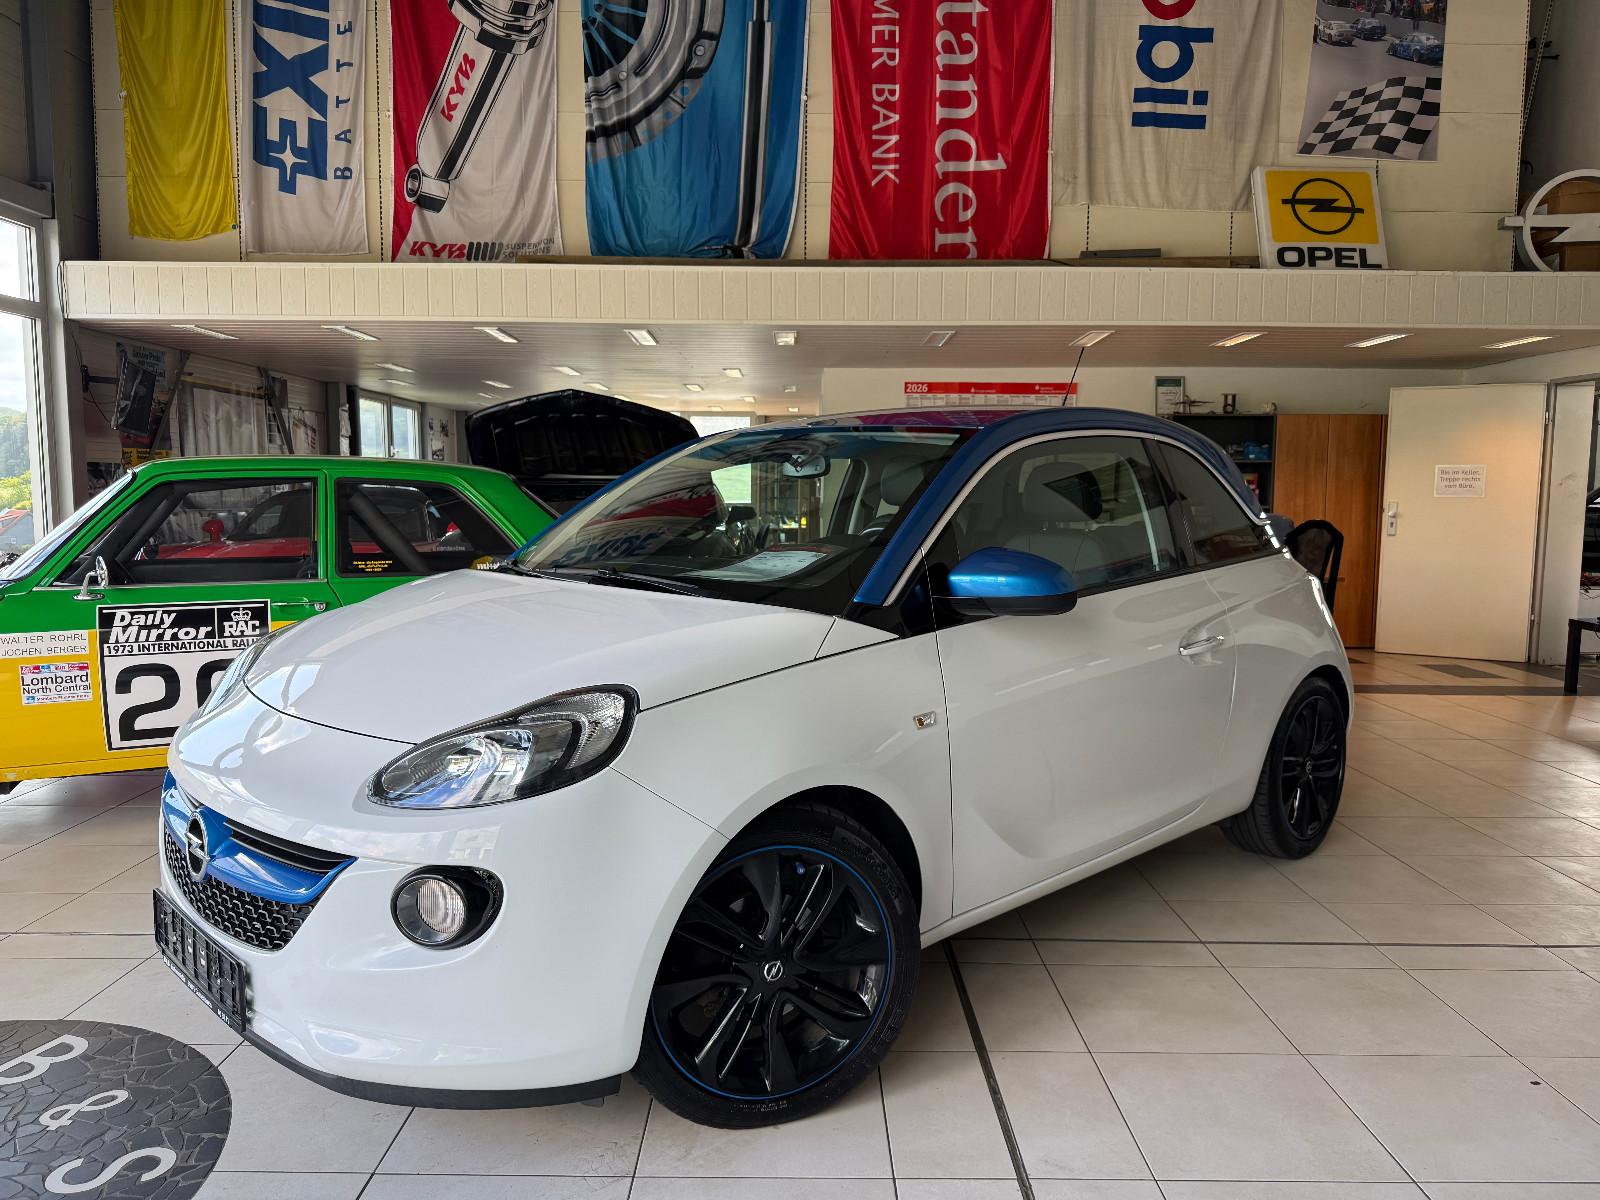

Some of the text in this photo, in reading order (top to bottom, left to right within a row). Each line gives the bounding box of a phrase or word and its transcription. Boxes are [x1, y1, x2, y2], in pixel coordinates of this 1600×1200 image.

[441, 53, 476, 122] KYB
[253, 0, 329, 195] EXI
[871, 83, 900, 188] BANK
[408, 241, 468, 260] KYB
[1276, 247, 1382, 269] OPEL
[906, 383, 928, 393] 2026
[113, 610, 177, 627] Daily
[108, 625, 212, 644] Mirror
[223, 621, 260, 637] RAC
[0, 635, 44, 645] WALTER
[106, 638, 260, 655] 1973 INTERNATIONAL RAL
[2, 647, 42, 657] JOCHEN
[21, 671, 89, 687] Lombard
[22, 683, 91, 695] North Central
[45, 1147, 177, 1194] S
